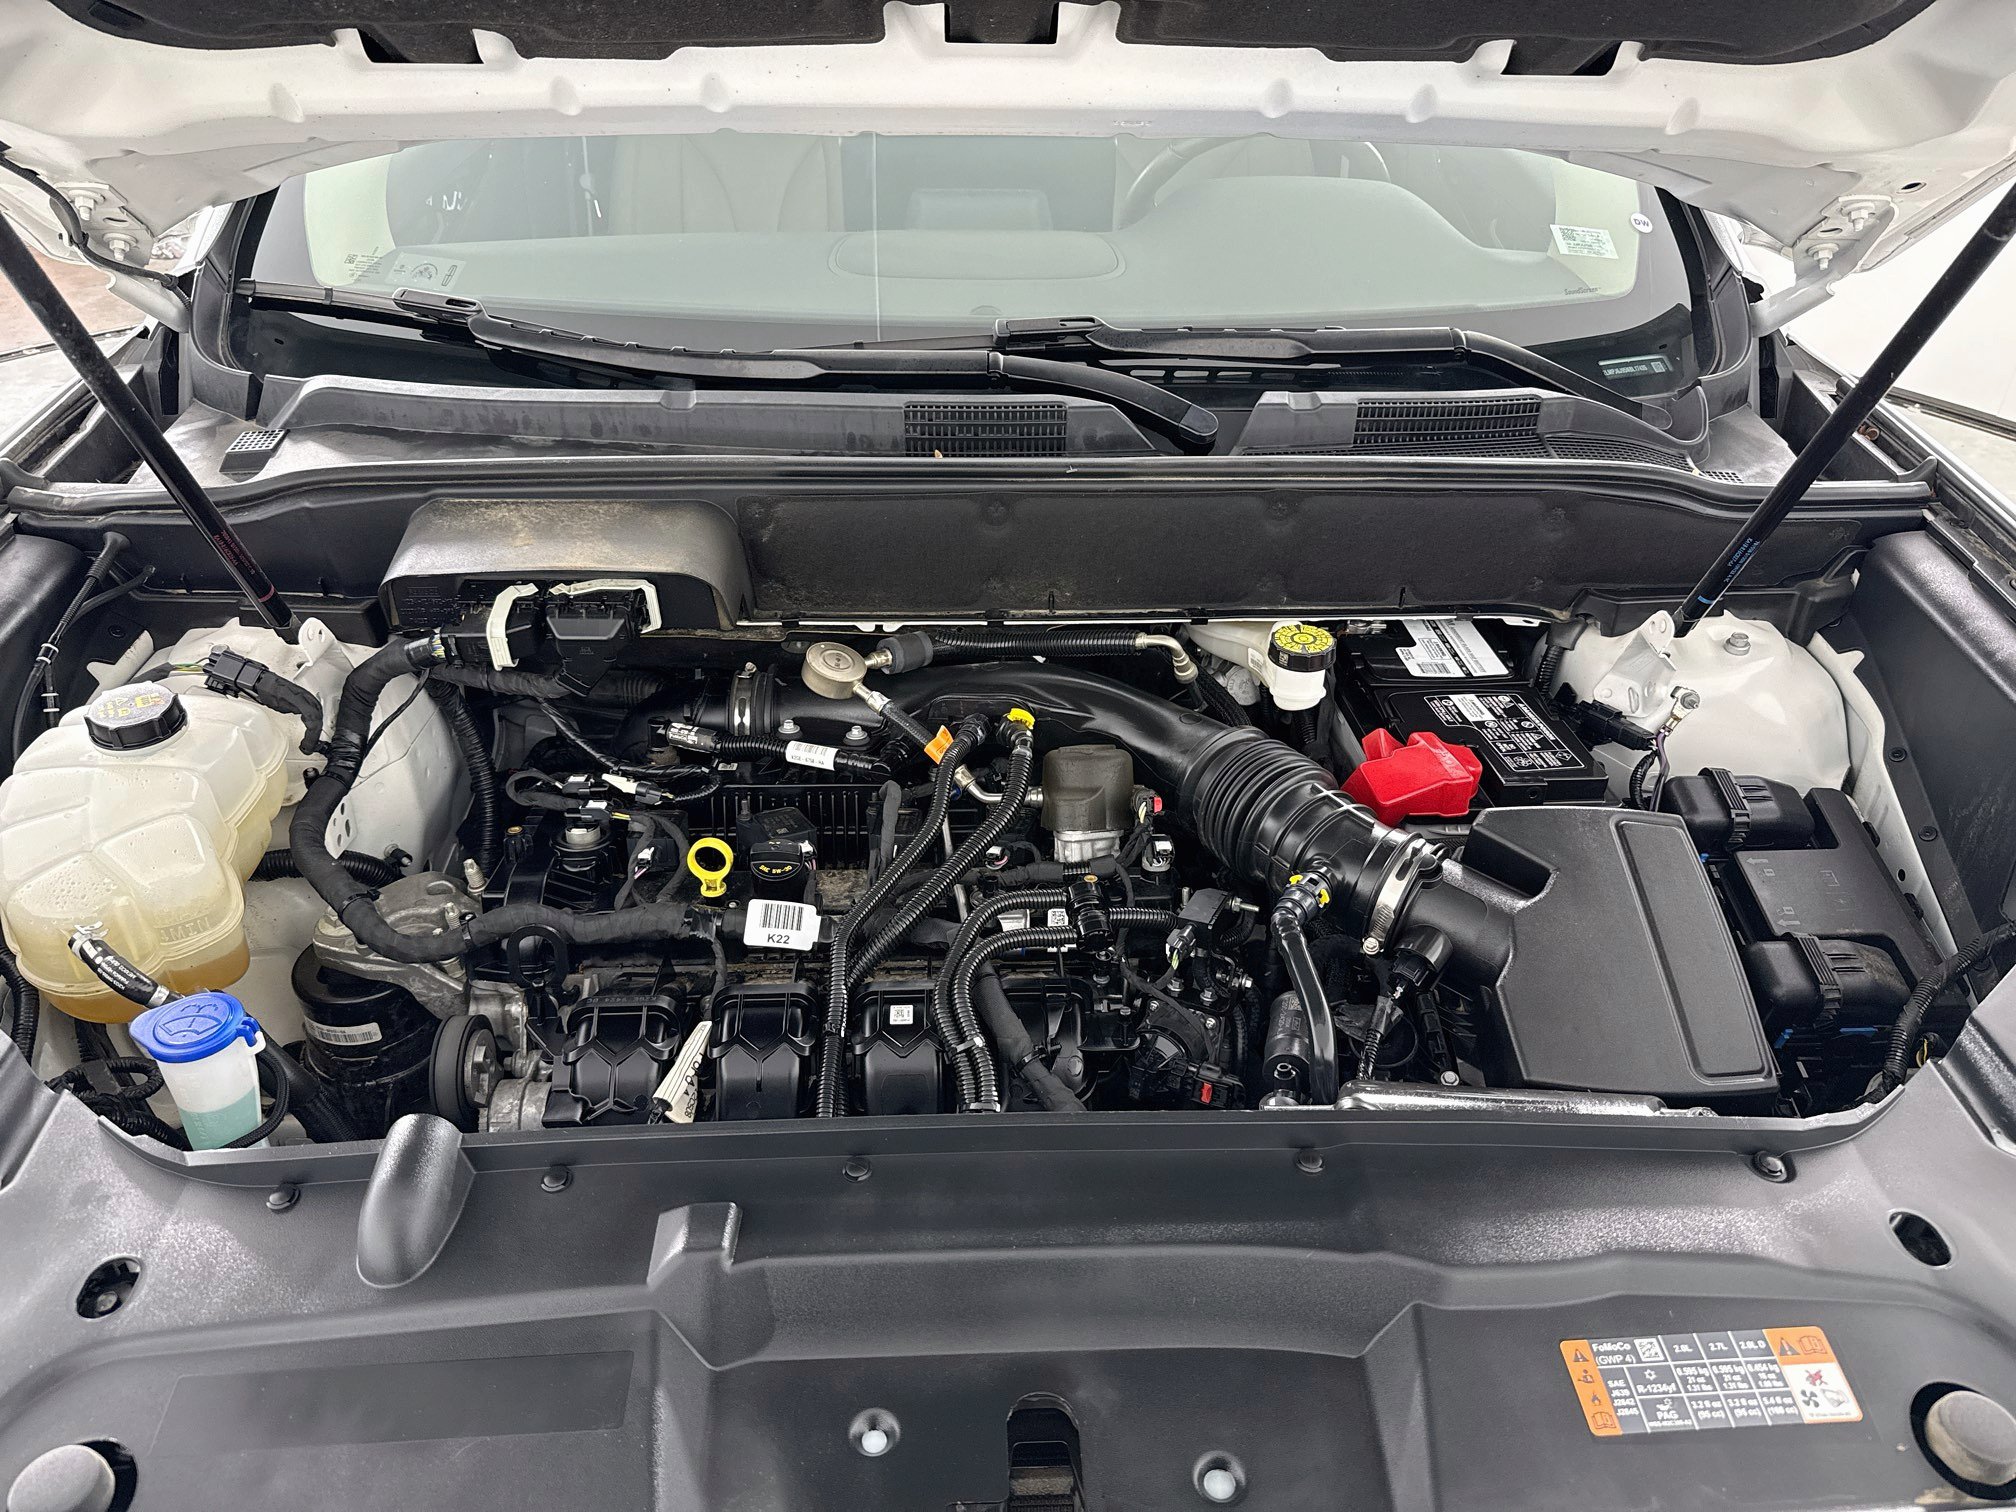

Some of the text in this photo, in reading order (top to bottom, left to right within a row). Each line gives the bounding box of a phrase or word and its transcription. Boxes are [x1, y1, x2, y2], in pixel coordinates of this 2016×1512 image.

[1634, 218, 1649, 227] DW
[767, 933, 790, 944] K22
[1592, 1341, 1631, 1352] FoMoCo
[1708, 1342, 1728, 1351] 2.7L
[1595, 1354, 1636, 1366] (GWP 4)
[1656, 1410, 1678, 1419] PAG
